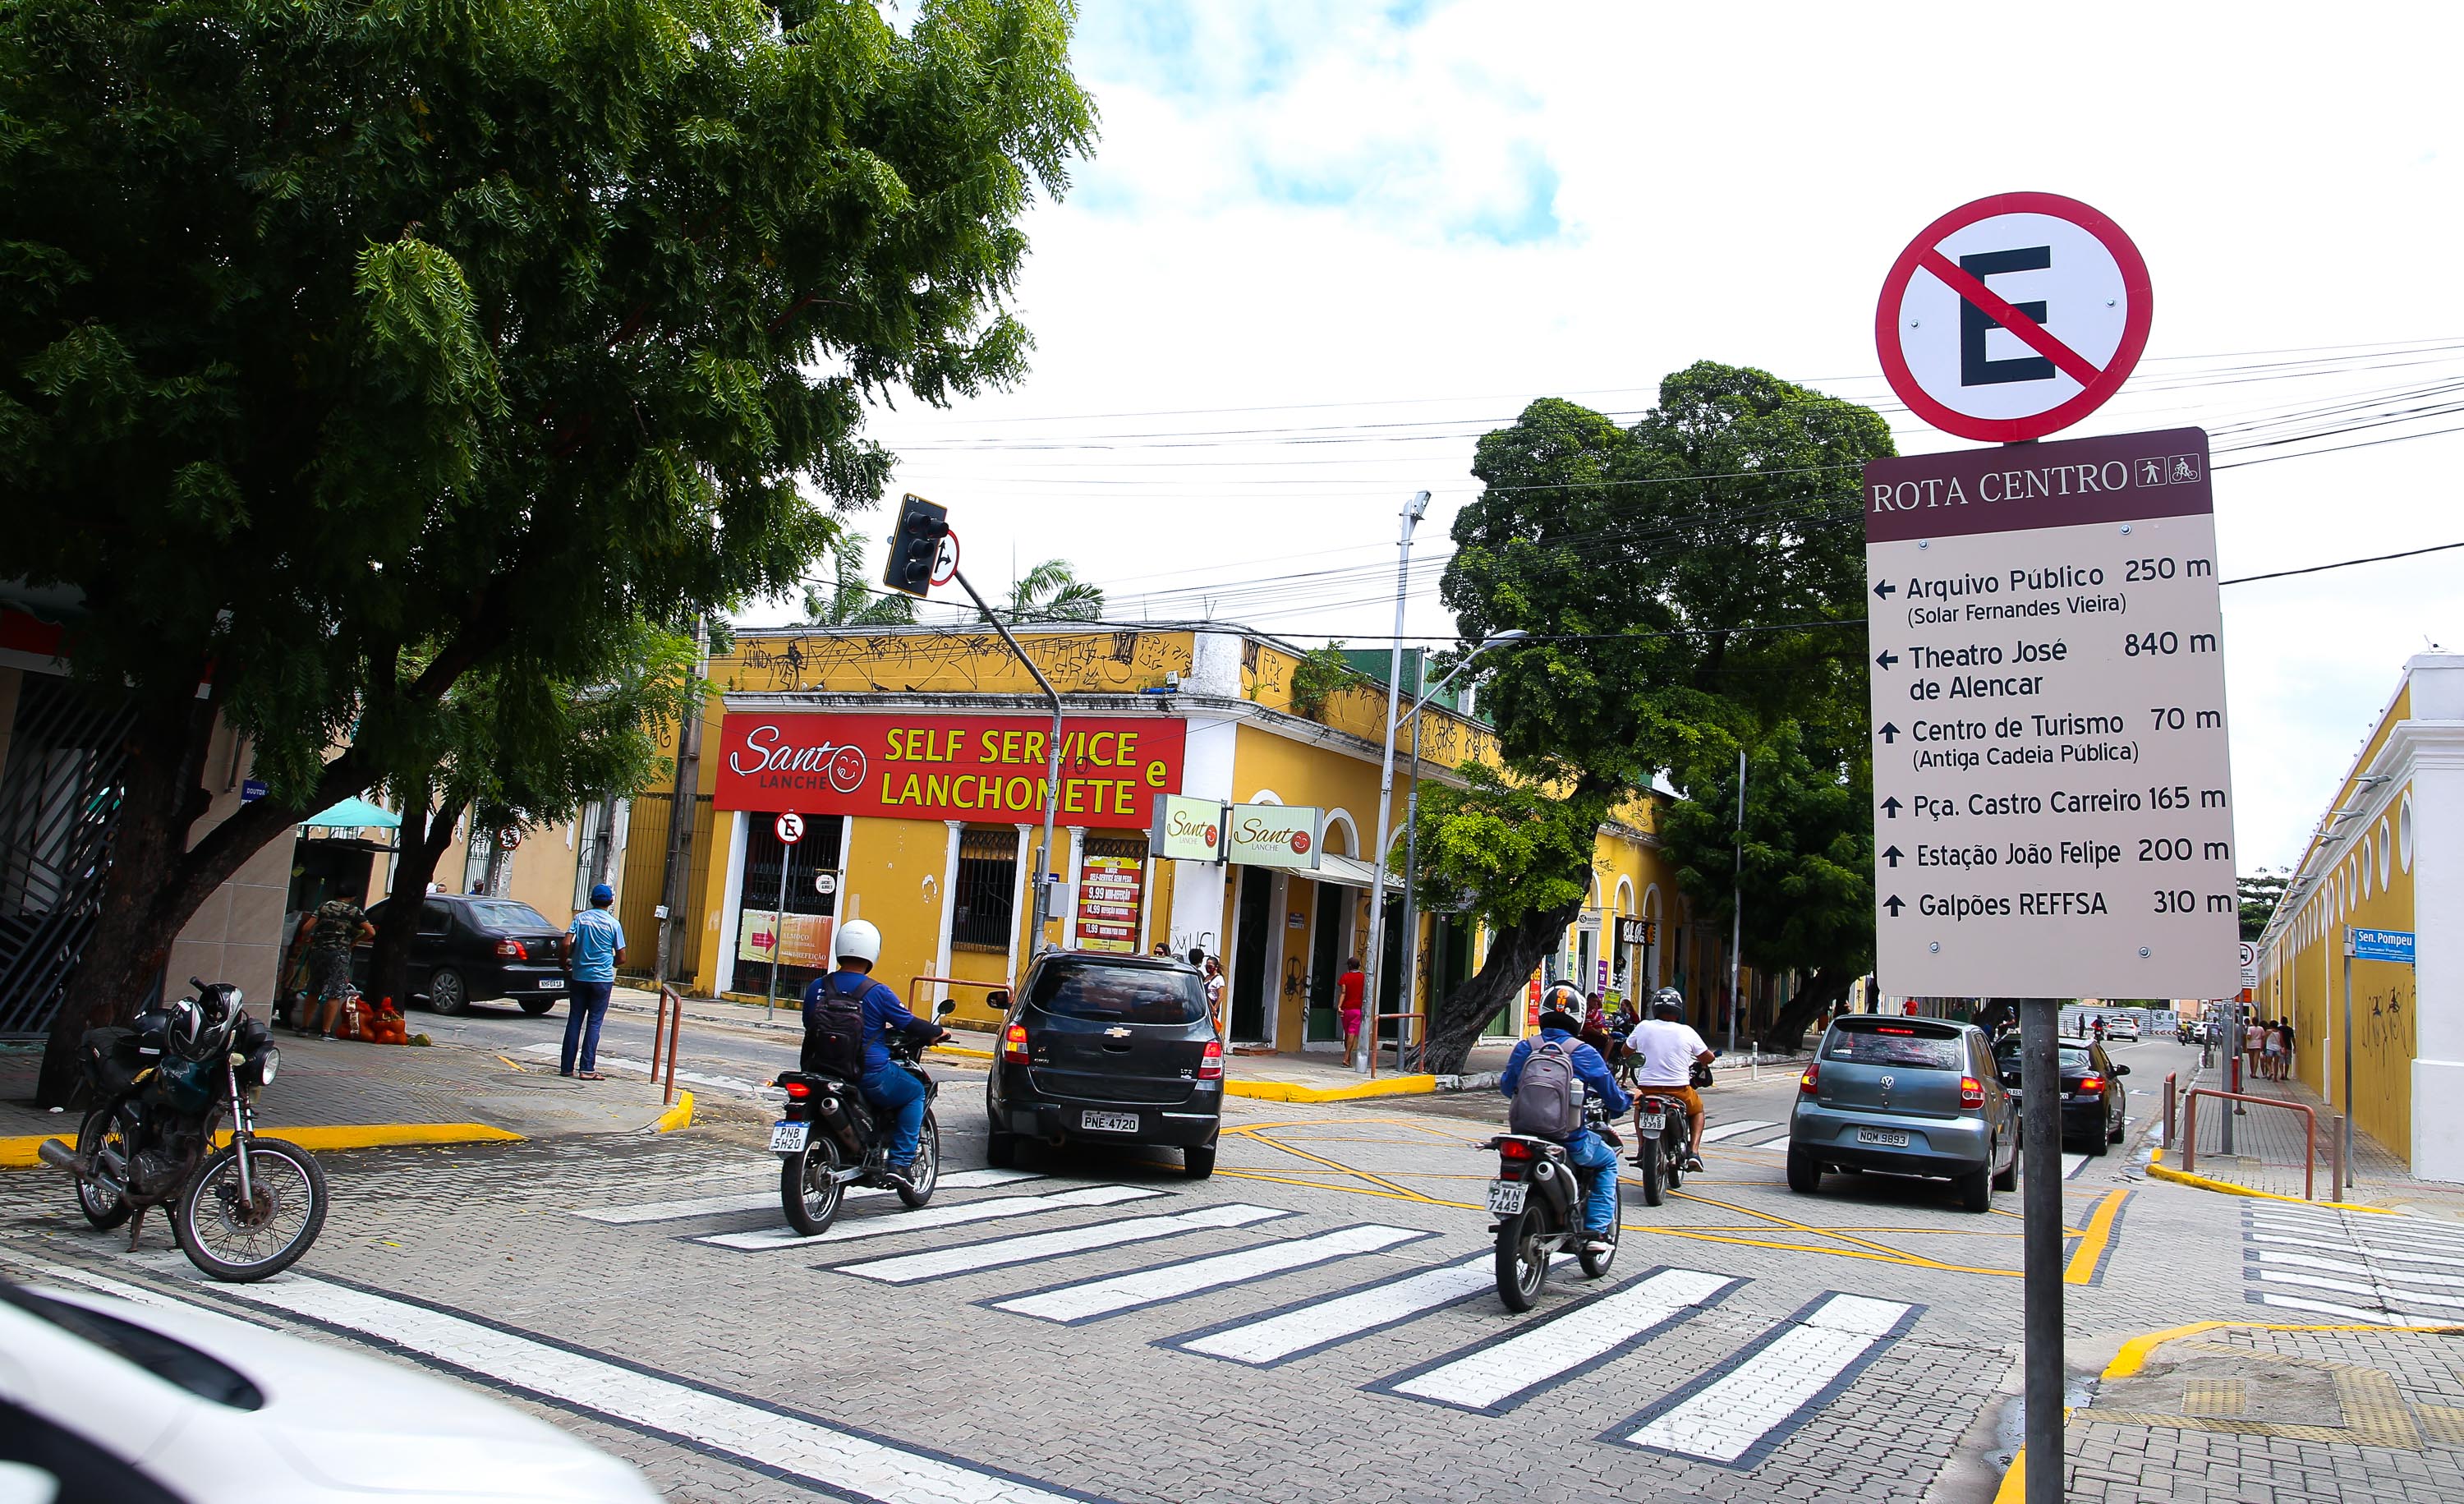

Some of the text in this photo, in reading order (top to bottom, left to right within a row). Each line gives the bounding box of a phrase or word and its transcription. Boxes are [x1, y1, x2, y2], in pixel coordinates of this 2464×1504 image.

[1872, 461, 2128, 513] ROTA CENTRO
[1906, 556, 2212, 602] Arquivo Público 250 m
[1907, 593, 2127, 628] (Solar Fernandes Vieira)
[1909, 631, 2217, 670] Theatro José 840 m
[1910, 674, 2043, 701] de Alencar
[1912, 707, 2222, 743] Centro de Turismo 70 m
[885, 727, 966, 763] SELF
[1145, 760, 1167, 789] e
[1913, 741, 2140, 771] (Antiga Cadeia Pública)
[760, 775, 828, 789] LANCHE
[1914, 786, 2227, 822] Pça. Castro Carreiro 165 m
[1252, 843, 1279, 852] LANCHE
[1917, 838, 2230, 871] Estação João Felipe 200 m
[1919, 890, 2233, 922] Galpões REFFSA 310 m
[2358, 931, 2412, 947] Sen. Pompeu
[780, 1128, 800, 1138] PNB
[1882, 1134, 1905, 1144] 9893
[1489, 1200, 1519, 1212] 7449
[1490, 1189, 1520, 1200] PMN
